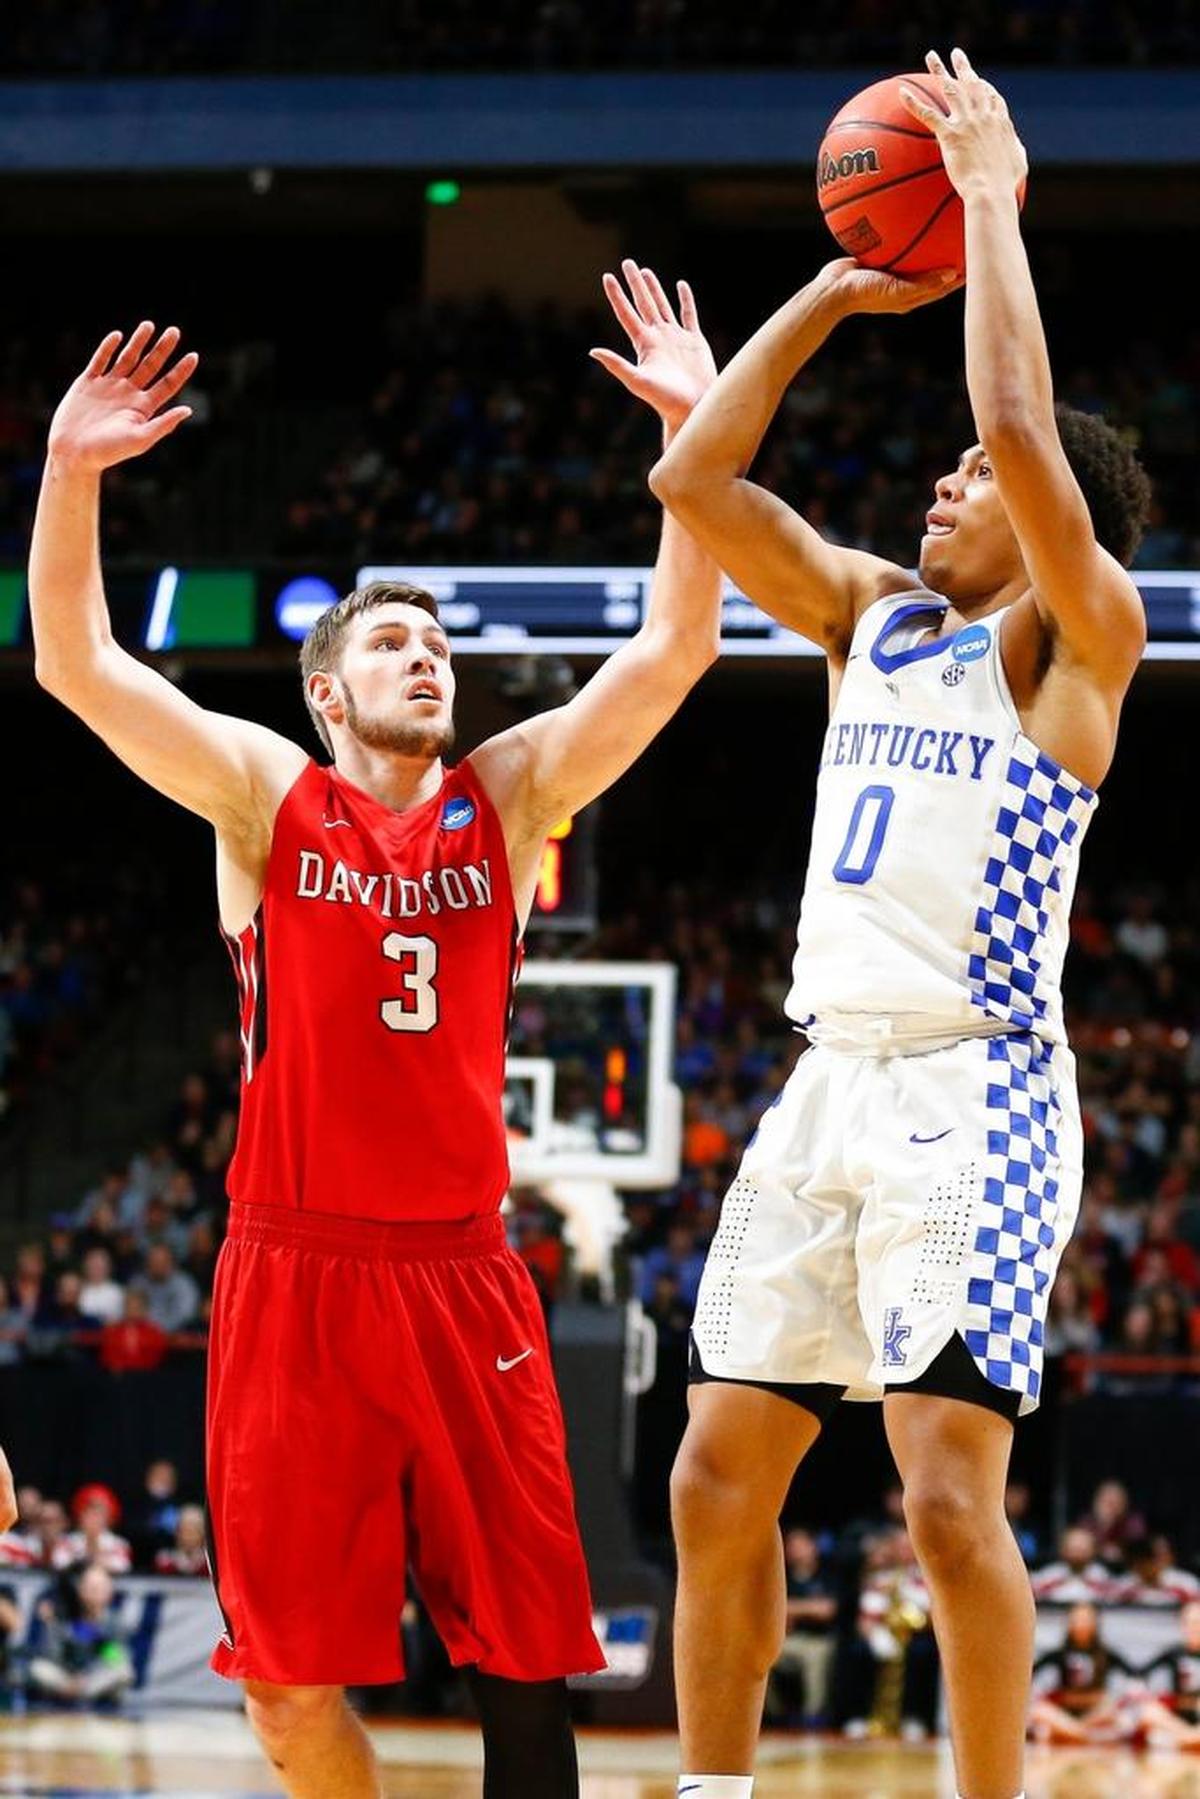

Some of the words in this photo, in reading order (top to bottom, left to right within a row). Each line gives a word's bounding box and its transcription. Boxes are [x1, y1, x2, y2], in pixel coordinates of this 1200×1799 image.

[956, 638, 989, 656] NCAA
[824, 723, 995, 780] ENTUCKY
[832, 785, 895, 885] 0
[297, 849, 492, 918] DAVIDSON
[380, 931, 440, 1033] 3
